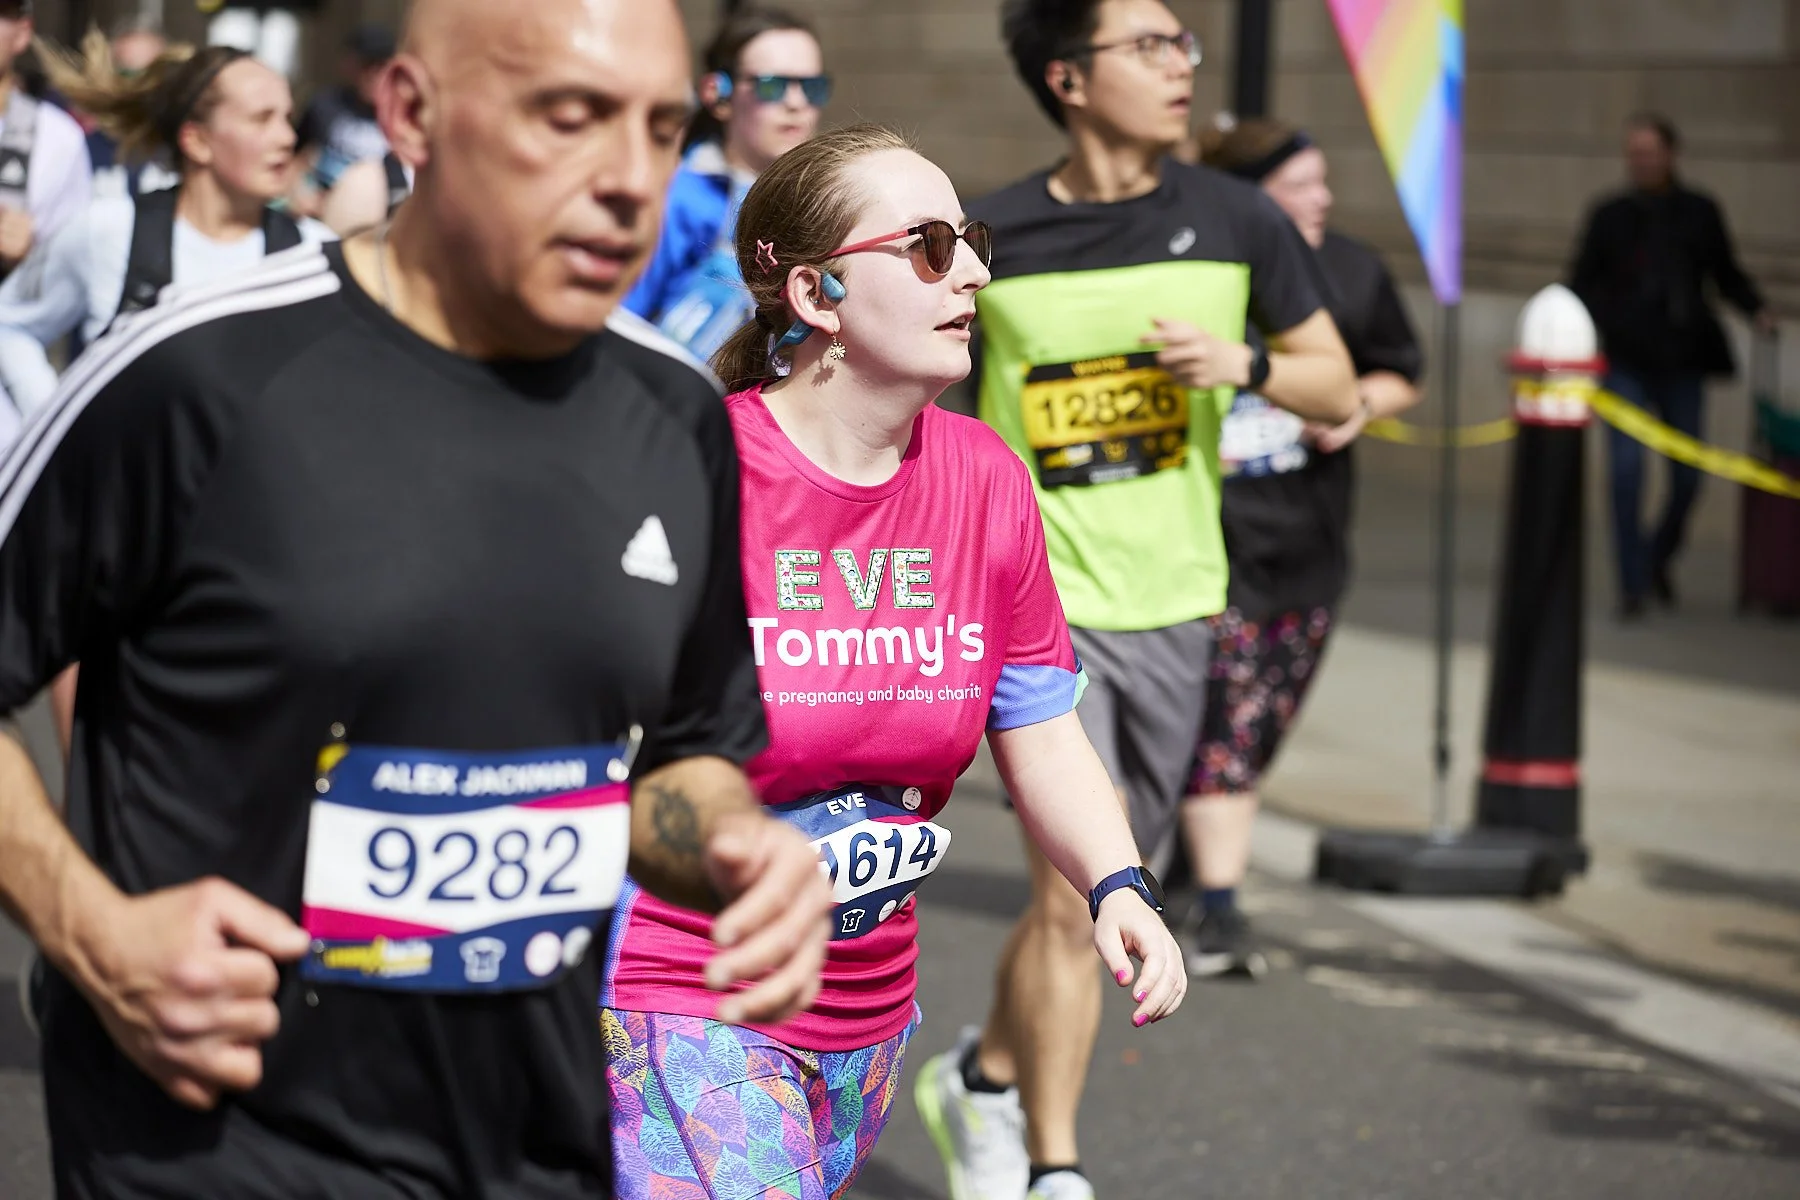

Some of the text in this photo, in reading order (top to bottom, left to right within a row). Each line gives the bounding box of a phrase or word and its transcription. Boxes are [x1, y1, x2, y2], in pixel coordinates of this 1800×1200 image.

[1039, 381, 1178, 430] 12826
[775, 548, 935, 610] EVE
[747, 614, 985, 677] Tommy's
[779, 690, 864, 706] pregnancy
[867, 684, 893, 701] and
[896, 684, 934, 704] baby
[937, 682, 982, 701] charit
[371, 760, 459, 797] ALEX
[826, 792, 867, 816] EVE
[367, 825, 580, 901] 9282
